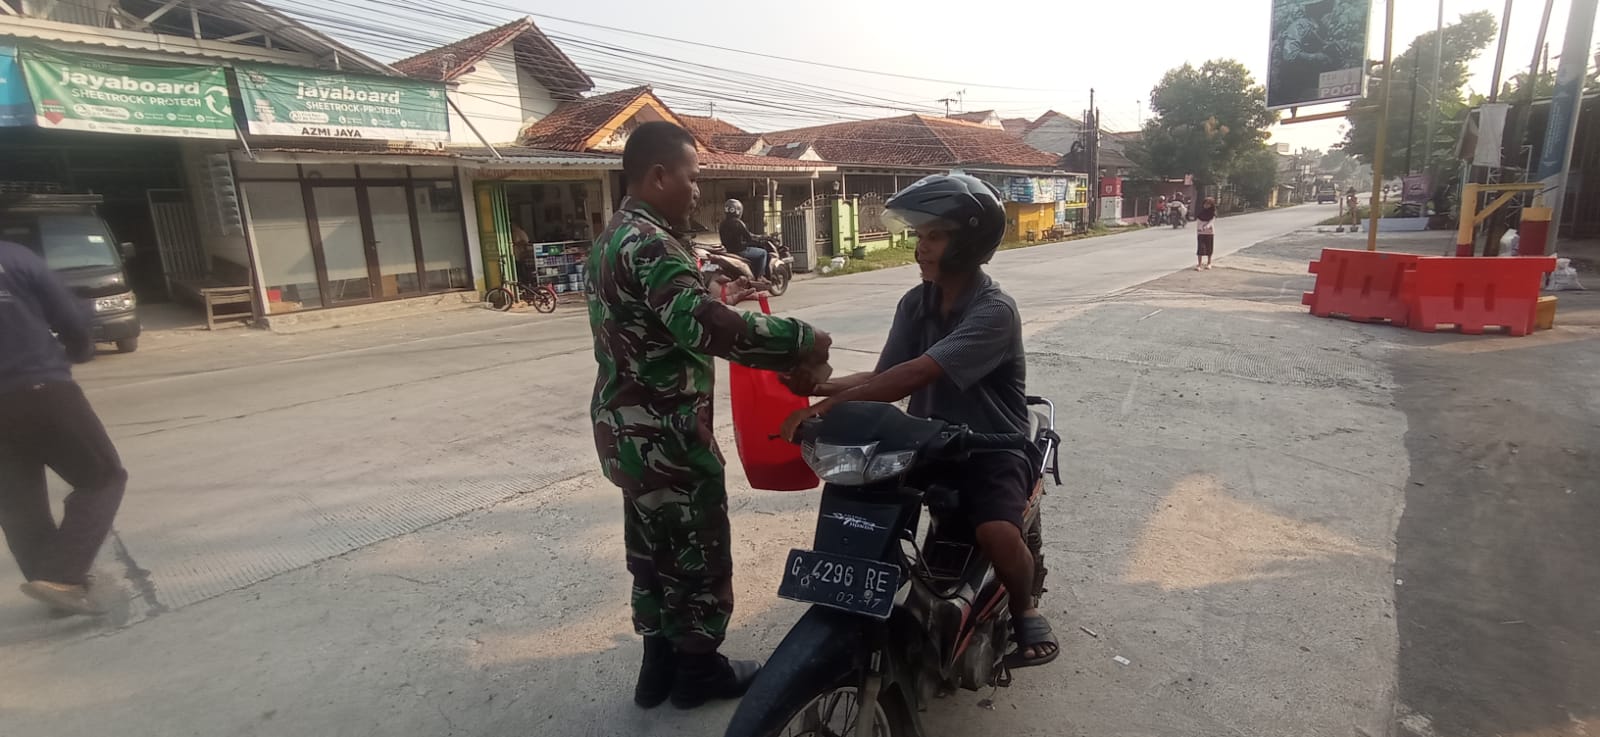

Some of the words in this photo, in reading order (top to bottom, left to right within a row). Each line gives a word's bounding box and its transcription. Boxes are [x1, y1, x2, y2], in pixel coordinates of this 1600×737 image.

[59, 67, 200, 95] jayaboard
[1321, 83, 1358, 99] POCI
[71, 88, 145, 105] SHEETROCK
[150, 96, 202, 108] PROTECH
[296, 82, 401, 105] jayaboard
[305, 101, 360, 113] SHEETROCK
[362, 105, 401, 116] PROTECH
[301, 126, 331, 137] AZMI
[333, 128, 363, 139] JAYA
[791, 556, 803, 576] G
[812, 560, 855, 587] 4296
[864, 568, 890, 593] RE
